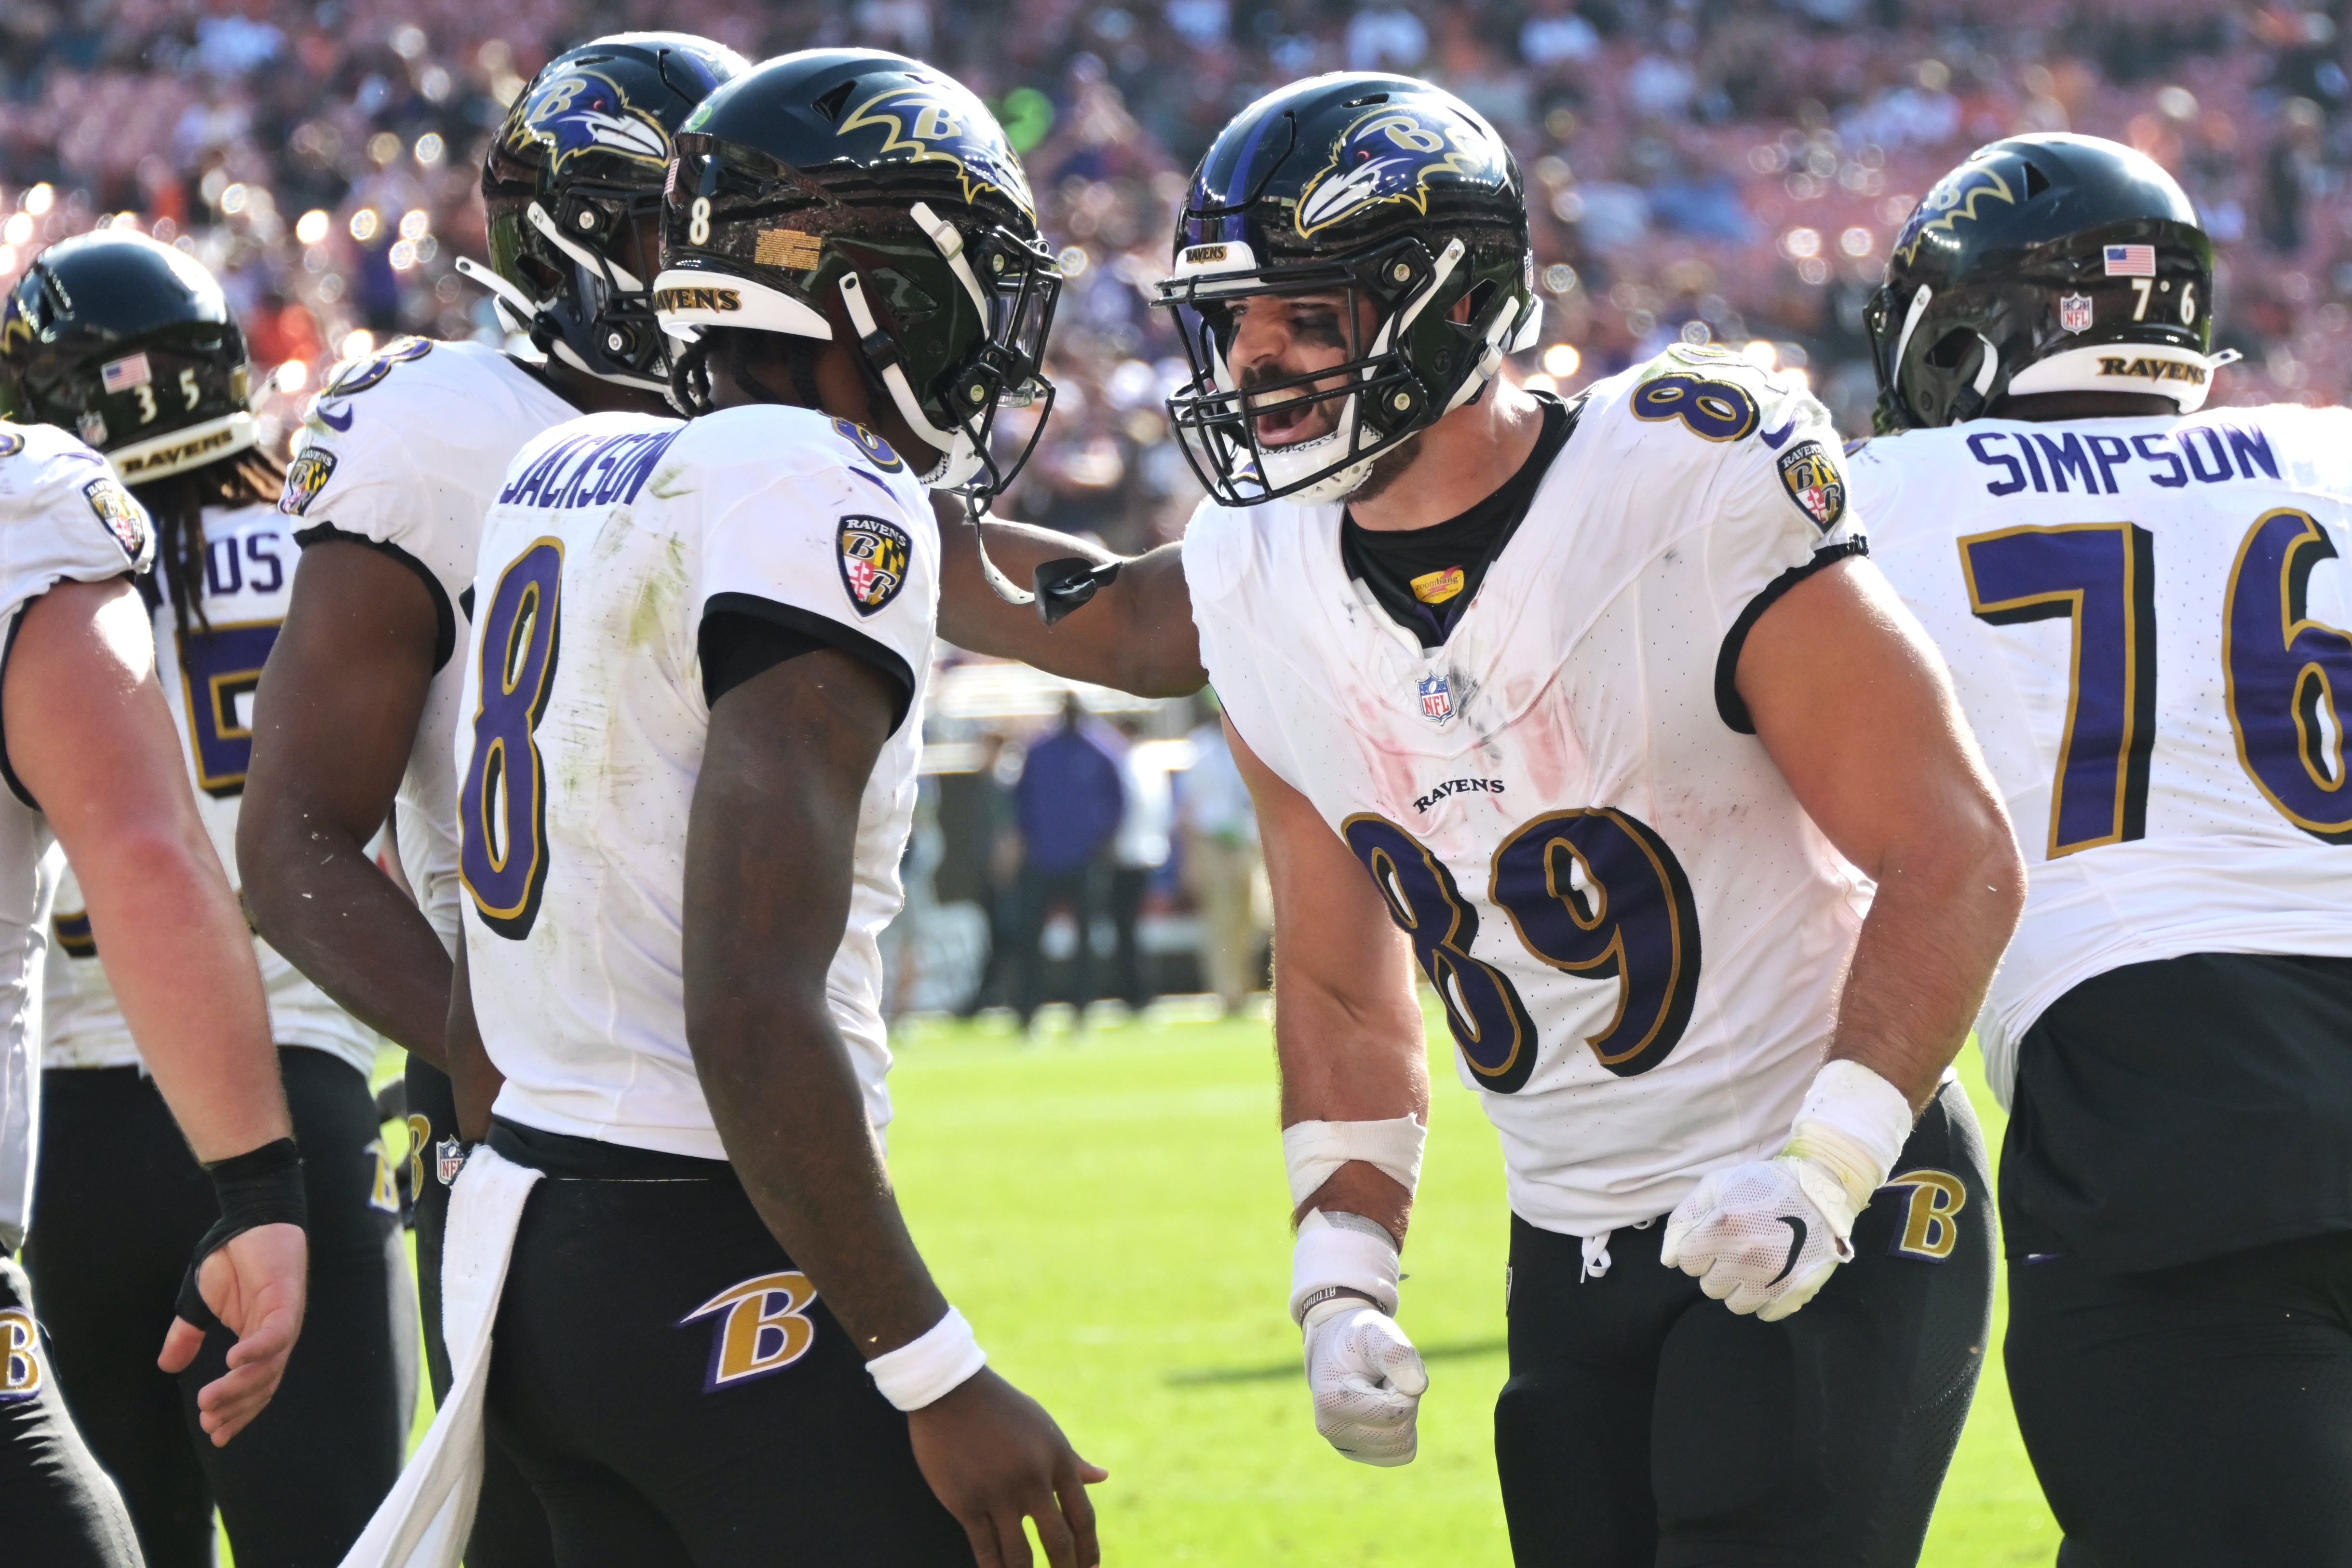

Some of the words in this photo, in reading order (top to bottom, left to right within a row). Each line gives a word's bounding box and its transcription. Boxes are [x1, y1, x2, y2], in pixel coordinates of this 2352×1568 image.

[689, 197, 711, 245] 8
[1186, 246, 1227, 264] RAVENS
[652, 287, 742, 315] AVENS
[2065, 311, 2088, 327] NFL
[2096, 357, 2207, 386] RAVENS
[119, 427, 233, 473] RAVENS
[1966, 423, 2282, 497] SIMPSON
[499, 425, 689, 509] JACKSON
[844, 532, 880, 559] B
[846, 519, 906, 547] RAVENS
[869, 569, 898, 600] R
[1415, 576, 1459, 591] zoombang
[1957, 506, 2352, 860] 76
[1423, 694, 1450, 716] NFL
[458, 536, 565, 941] 8
[1413, 779, 1505, 814] RAVENS
[1340, 806, 1702, 1095] 89
[442, 1160, 463, 1179] NF
[1876, 1169, 1967, 1259] B
[1303, 1286, 1336, 1314] ATTITUDE
[676, 1269, 819, 1389] B
